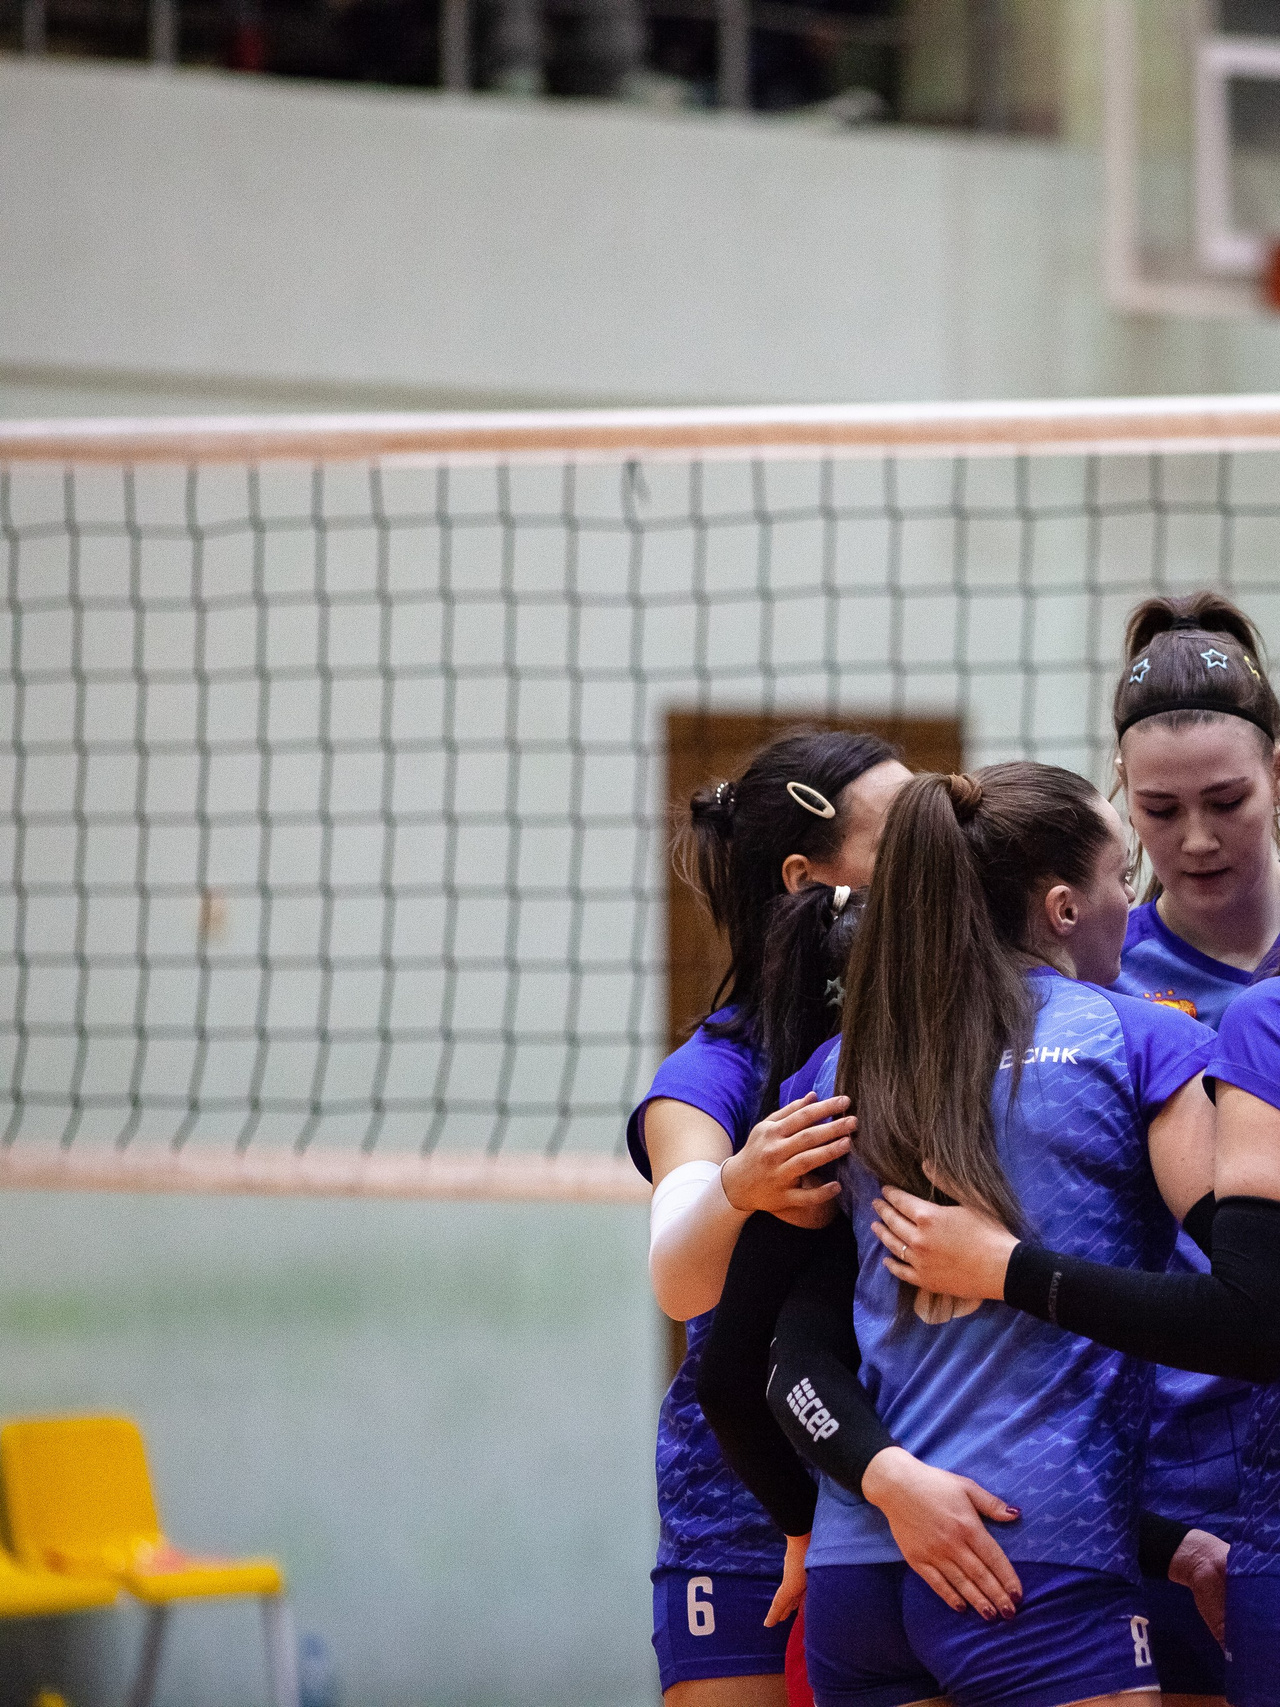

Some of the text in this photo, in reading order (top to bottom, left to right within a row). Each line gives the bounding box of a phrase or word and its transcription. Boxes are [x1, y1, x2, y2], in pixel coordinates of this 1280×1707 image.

[798, 1397, 840, 1442] cep
[687, 1576, 716, 1637] 6
[1130, 1615, 1153, 1668] 8
